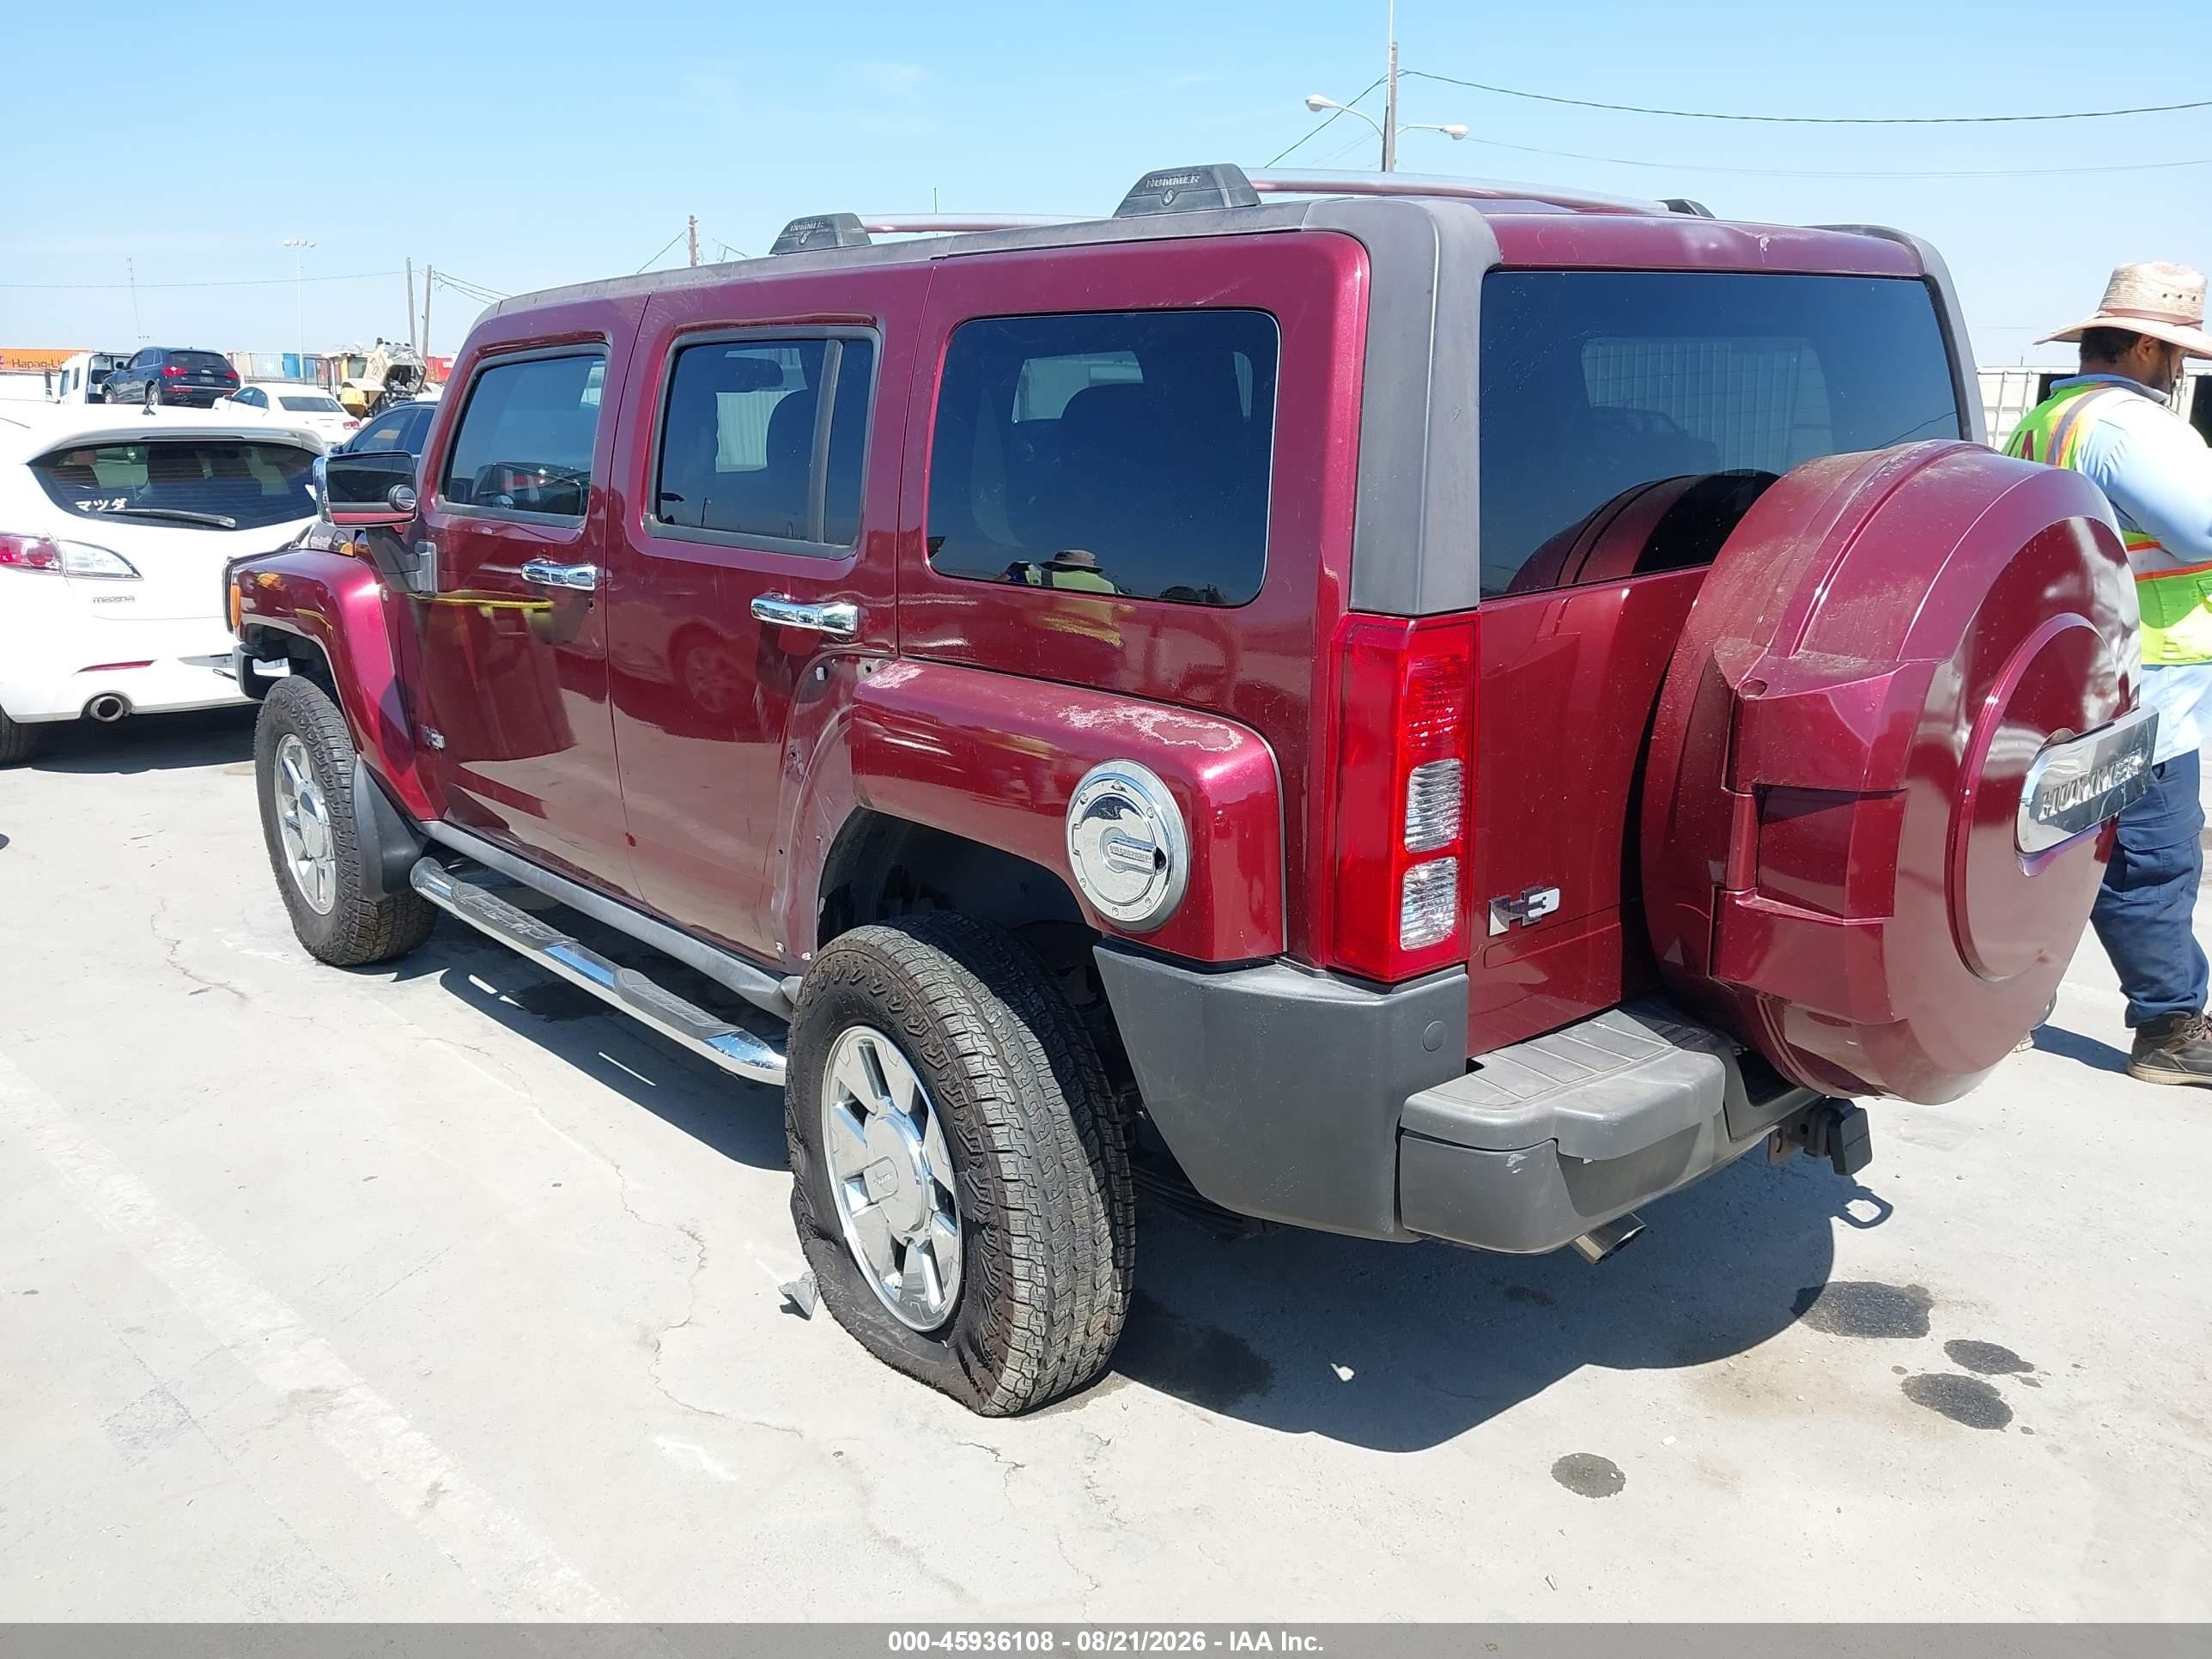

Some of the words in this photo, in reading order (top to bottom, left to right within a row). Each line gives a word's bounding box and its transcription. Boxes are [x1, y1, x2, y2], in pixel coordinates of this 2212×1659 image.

[1146, 175, 1200, 188] HUMMER
[75, 497, 128, 513] マツダ
[1487, 886, 1560, 937] H3
